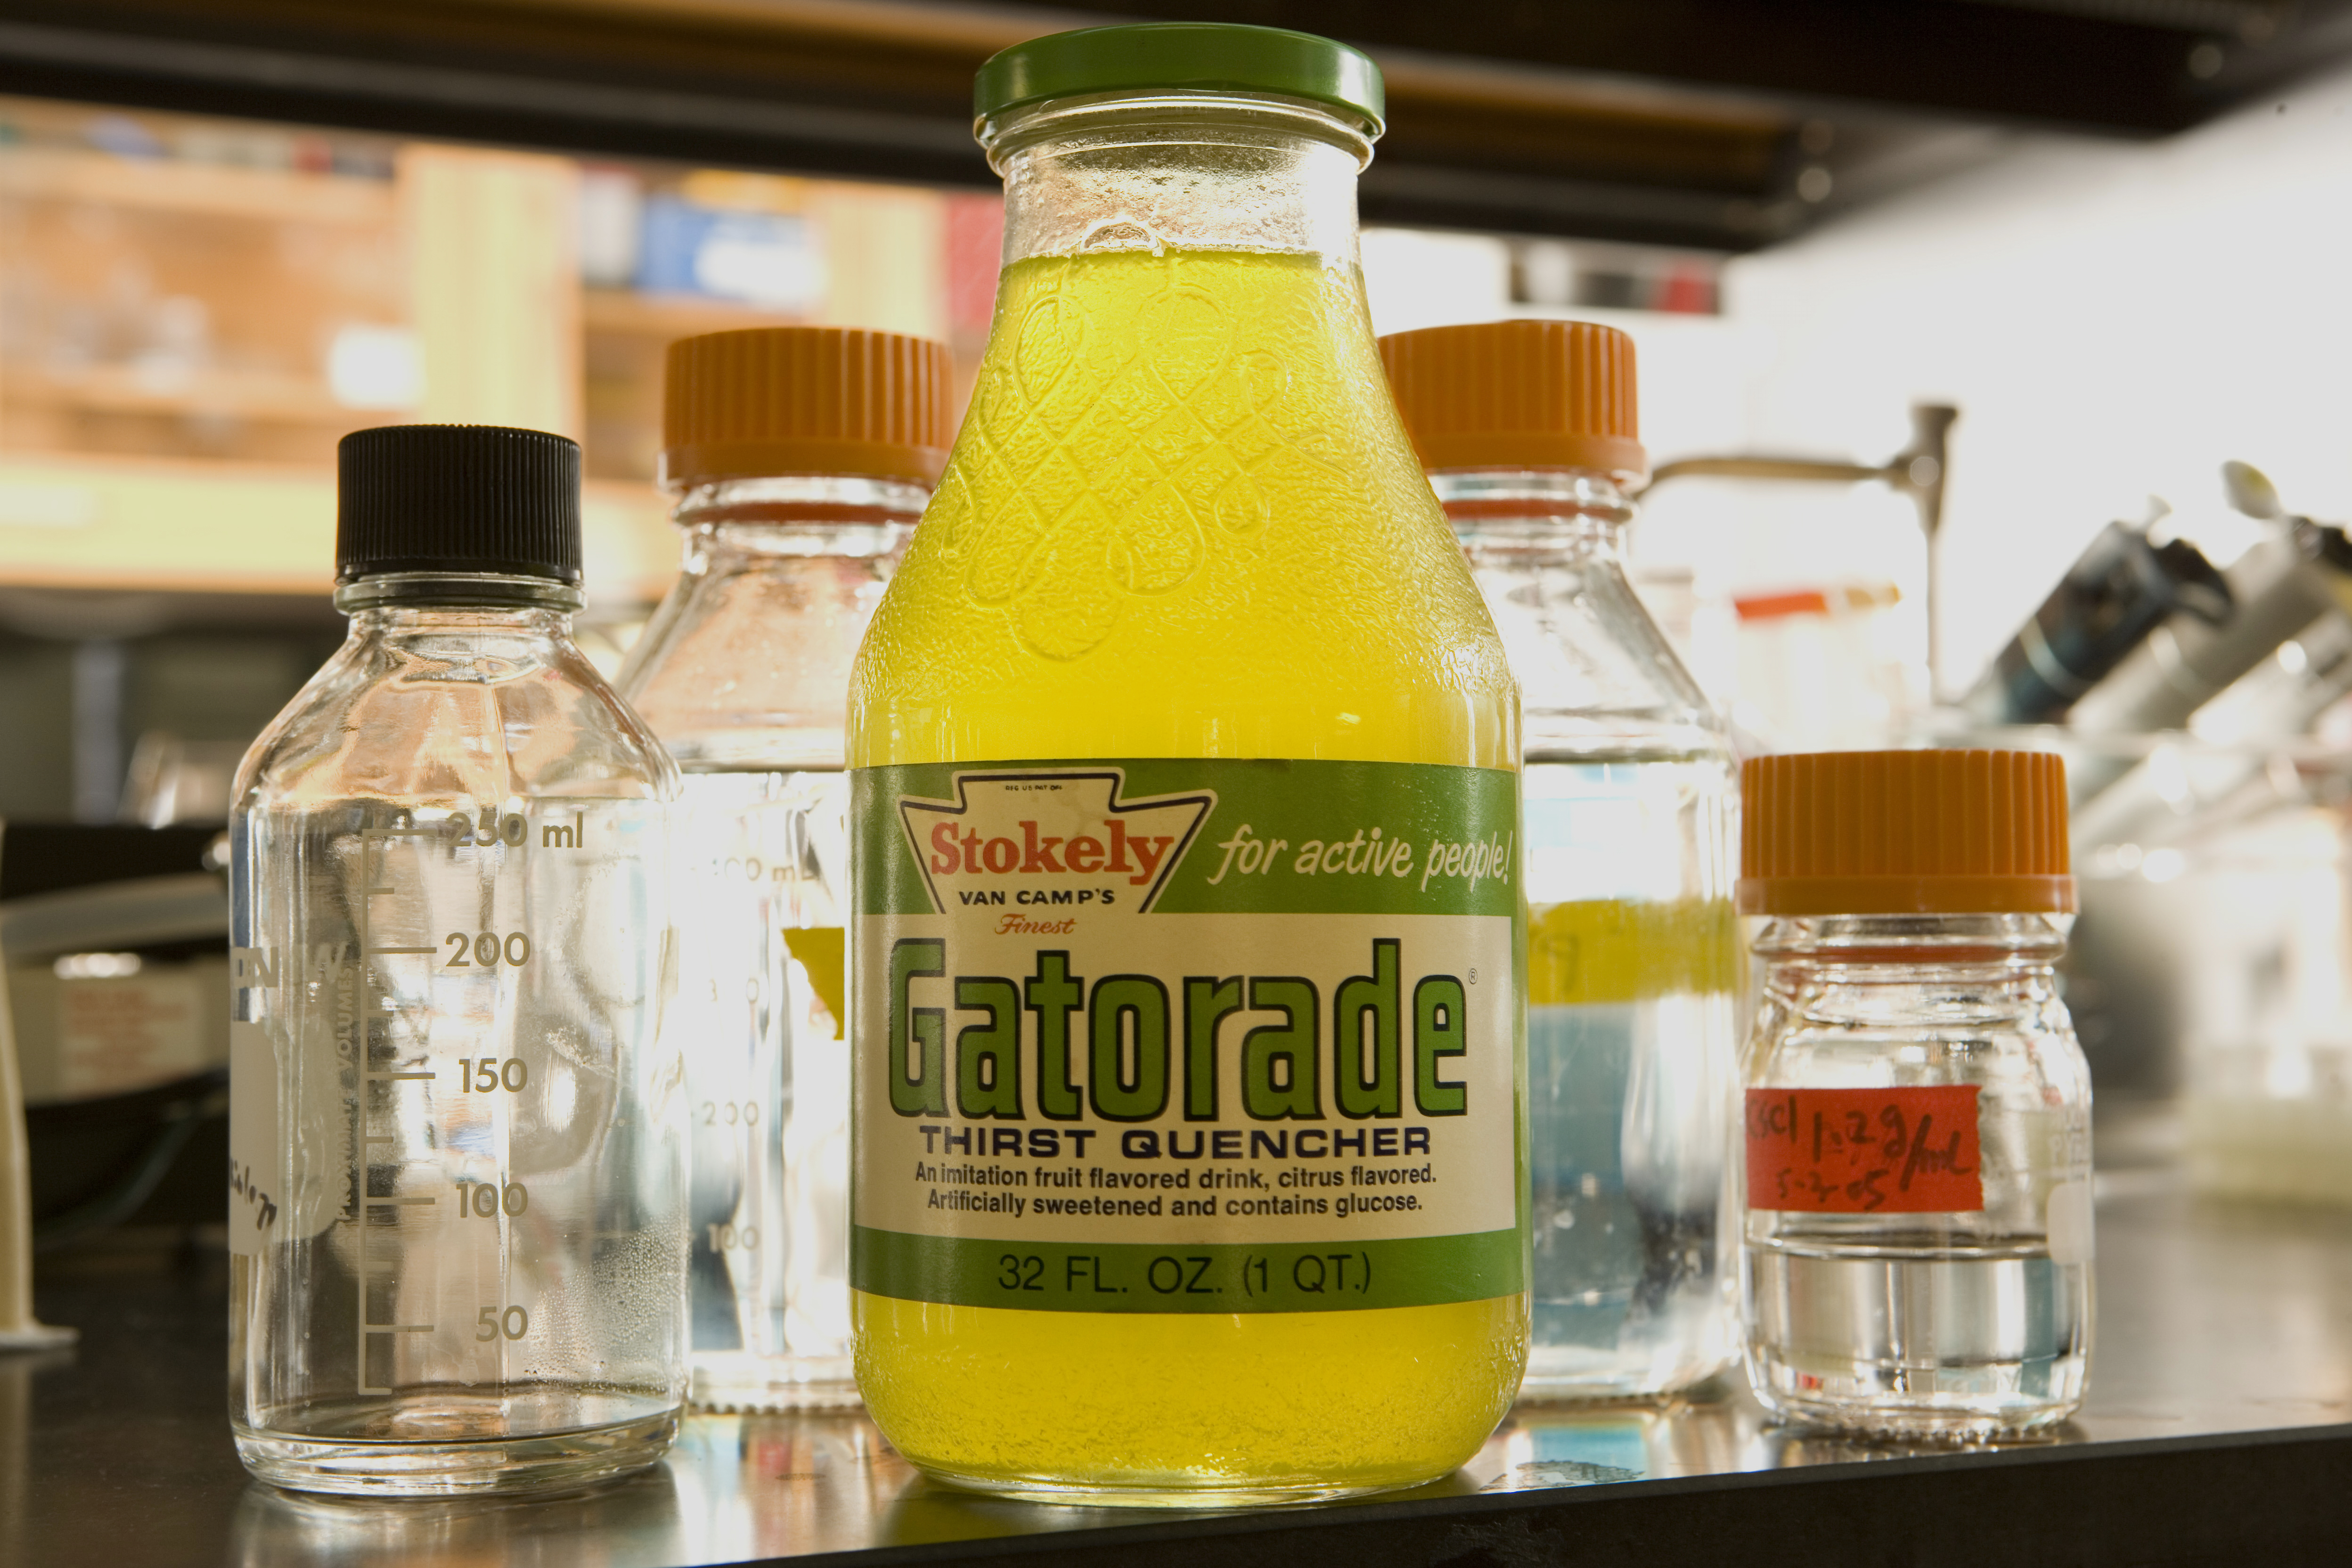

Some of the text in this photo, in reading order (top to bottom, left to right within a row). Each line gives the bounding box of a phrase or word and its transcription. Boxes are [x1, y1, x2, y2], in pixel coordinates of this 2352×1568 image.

[446, 810, 584, 848] 250 ml
[931, 819, 1175, 885] Stokely
[1208, 824, 1514, 893] for active people!
[959, 889, 1115, 905] VAN CAMP'S
[995, 913, 1078, 935] Finest
[446, 932, 531, 967] 200
[336, 967, 354, 1072] VOLUMES
[889, 938, 1468, 1121] Gatorade
[458, 1058, 528, 1092] 150
[703, 1101, 760, 1127] 200
[920, 1126, 1430, 1159] THIRST QUENCHER
[915, 1161, 1437, 1192] An imitation fruit flavored drink, citrus flavored.
[456, 1182, 528, 1218] 100
[928, 1188, 1423, 1218] Artificially sweetened and contains glucose.
[998, 1252, 1372, 1296] 32 FL. OZ. (1 QT.)
[476, 1306, 528, 1341] 50
